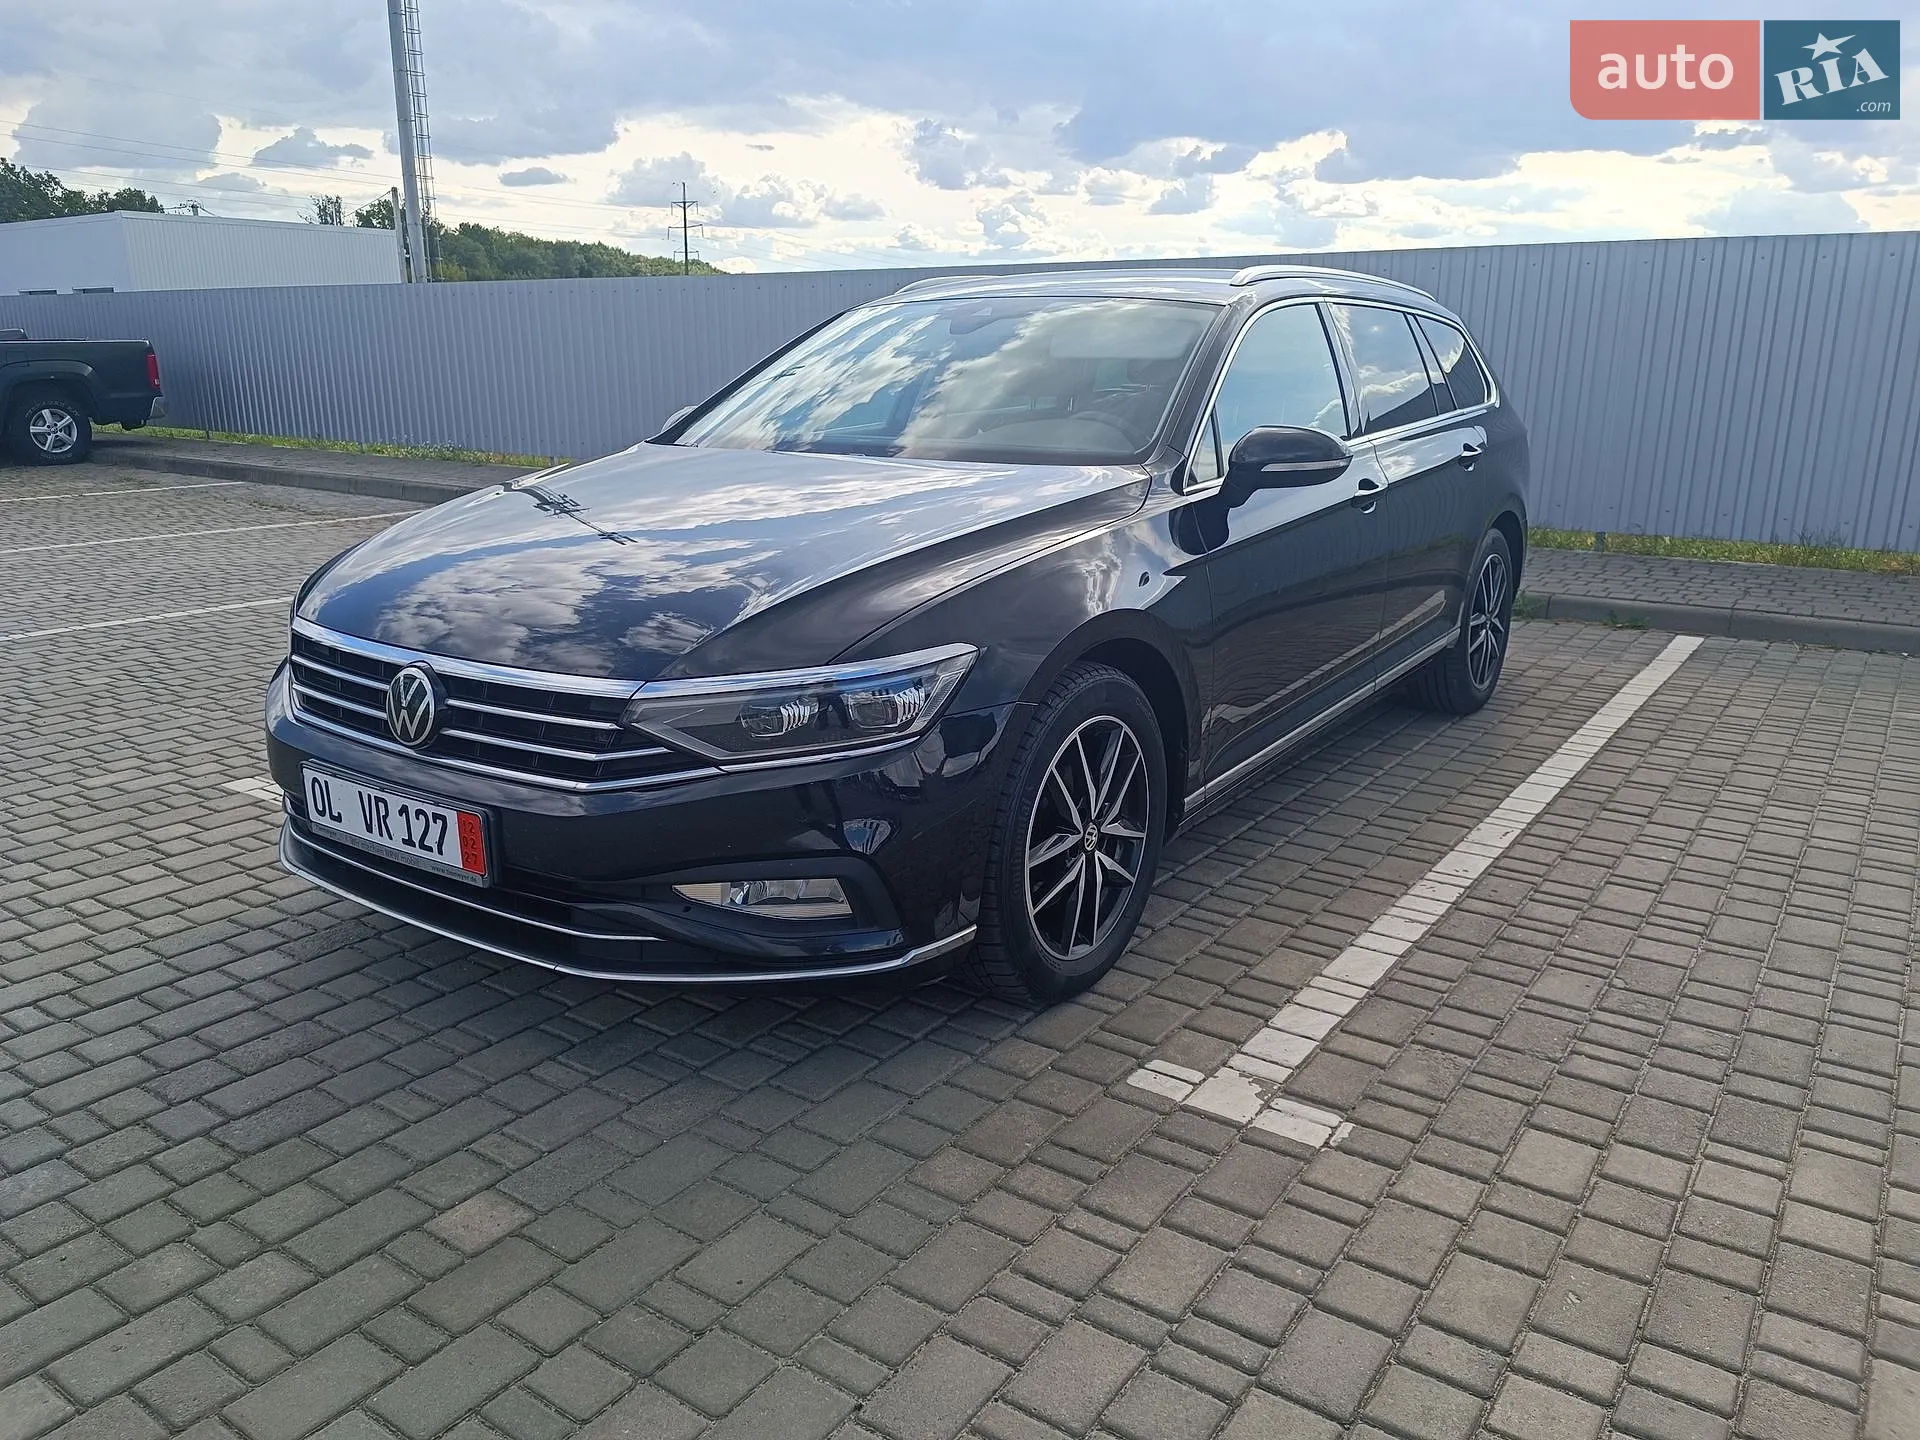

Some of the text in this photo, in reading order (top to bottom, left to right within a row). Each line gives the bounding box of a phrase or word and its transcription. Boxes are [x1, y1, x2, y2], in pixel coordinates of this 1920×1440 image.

[311, 776, 342, 823] OL
[358, 790, 393, 841] VR
[398, 803, 448, 856] 127
